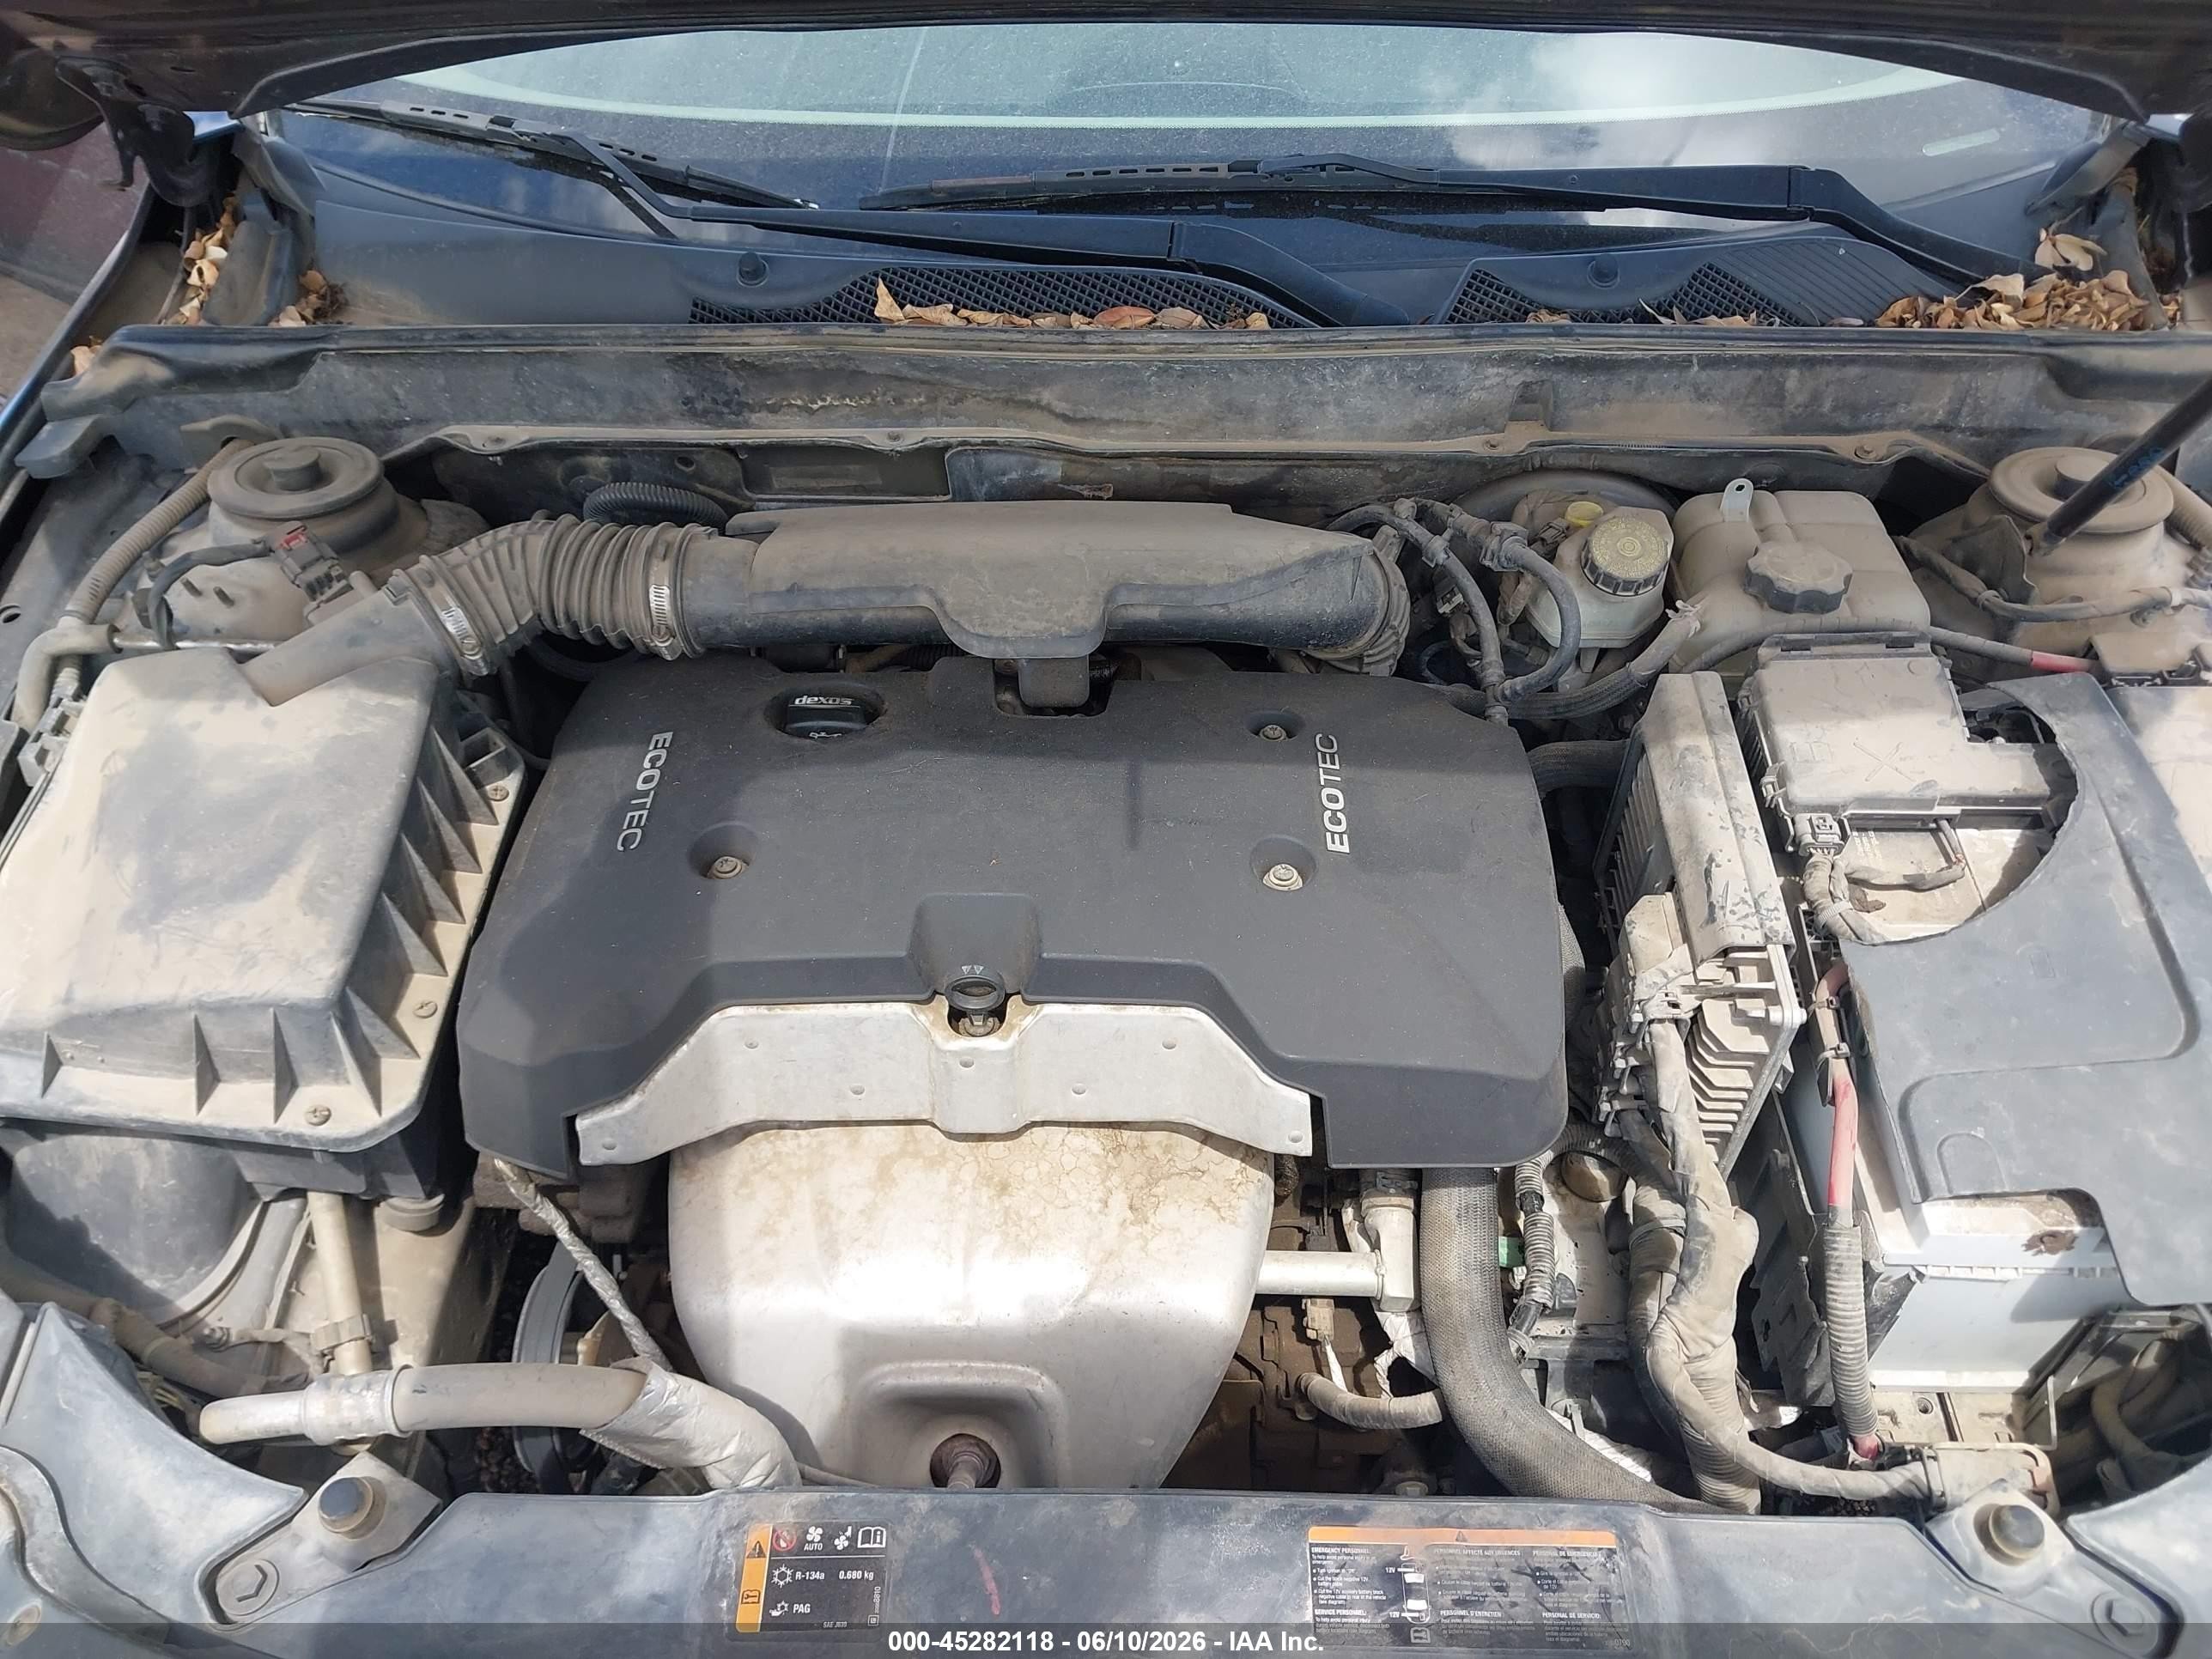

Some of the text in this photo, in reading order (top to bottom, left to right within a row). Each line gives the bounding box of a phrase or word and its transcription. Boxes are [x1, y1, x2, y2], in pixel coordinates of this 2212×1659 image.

[794, 695, 854, 705] dexos
[617, 731, 673, 851] ECOTEC
[1315, 733, 1350, 854] ECOTEC
[795, 1571, 825, 1580] R-134a
[839, 1571, 874, 1581] 0.680 kg
[793, 1603, 811, 1613] PAG
